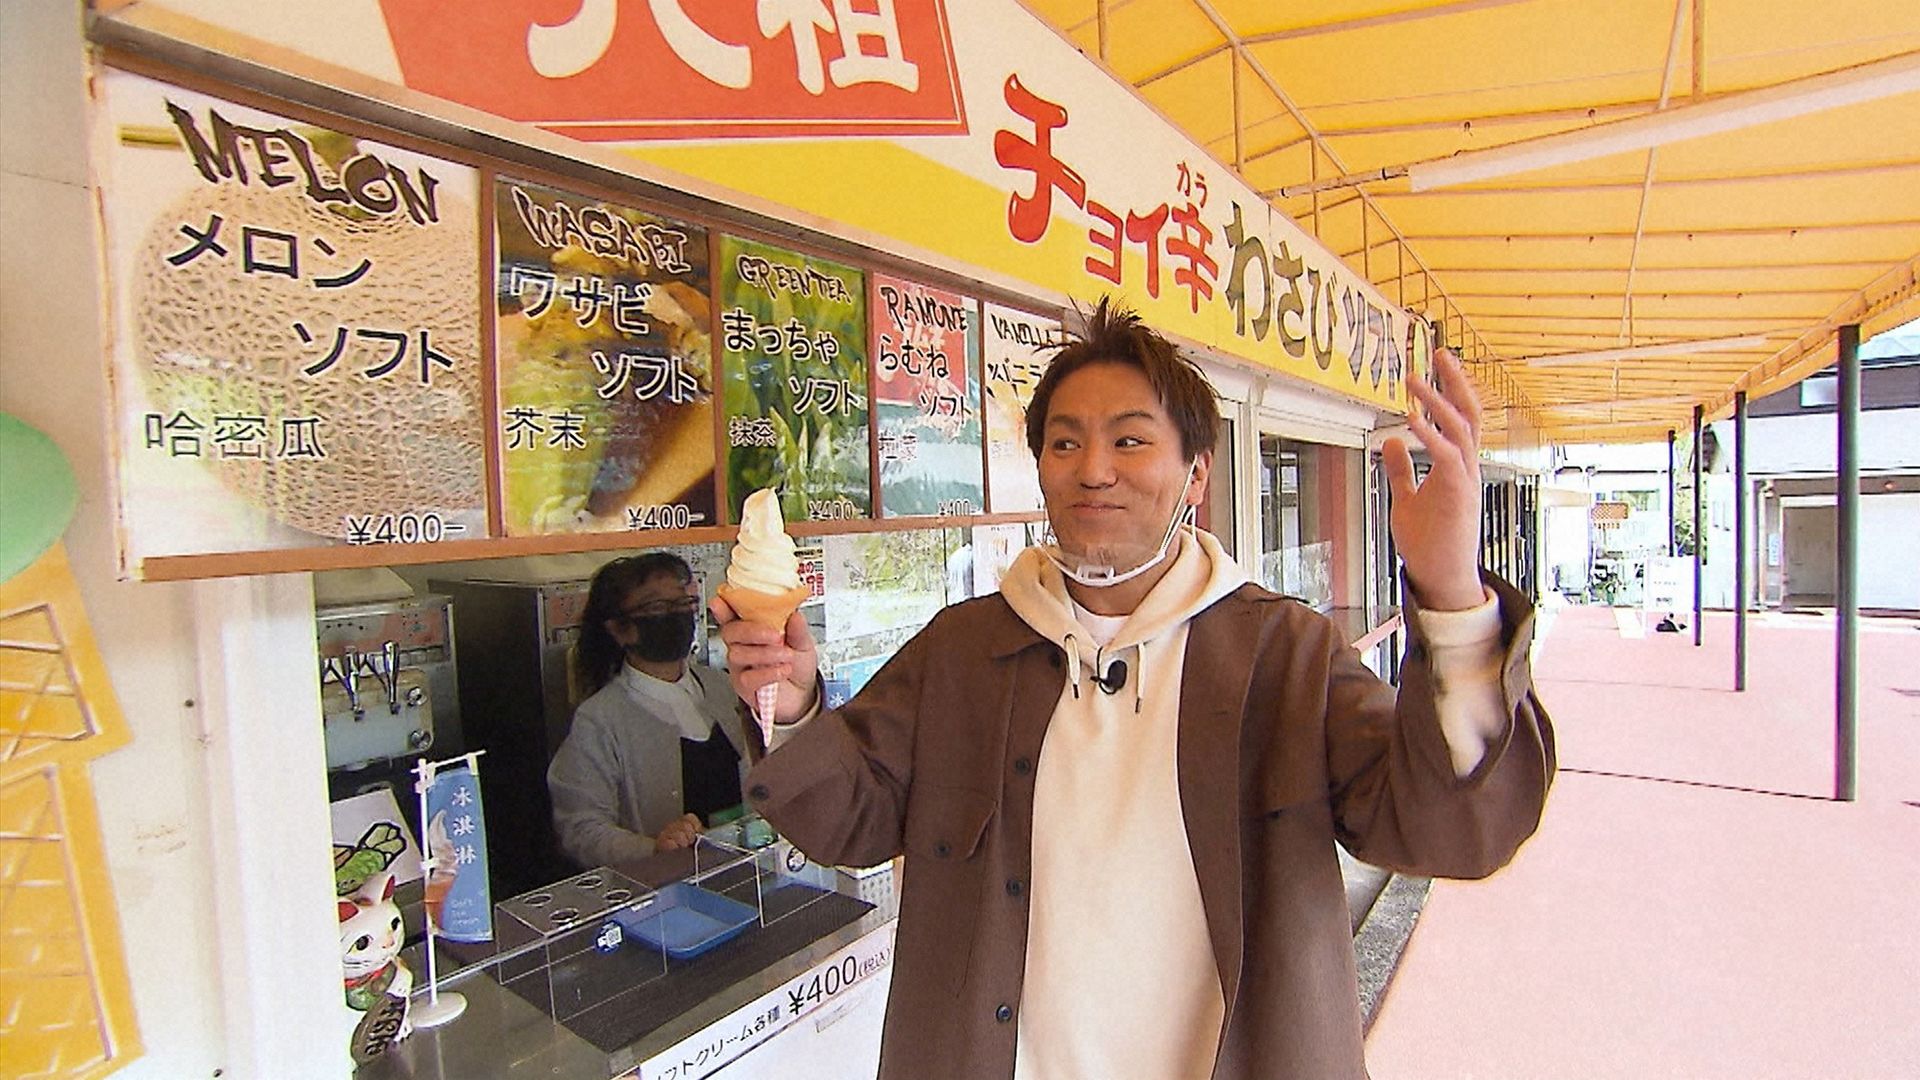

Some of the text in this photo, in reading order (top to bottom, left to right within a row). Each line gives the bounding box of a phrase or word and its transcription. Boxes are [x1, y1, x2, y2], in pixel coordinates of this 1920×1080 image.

[164, 96, 440, 226] MELON
[1176, 161, 1208, 208] カラ
[166, 213, 373, 288] メロン
[511, 184, 692, 275] WASABI
[509, 266, 653, 336] ワサビ
[879, 286, 969, 332] RAMUNE
[291, 321, 454, 384] ソフト
[721, 307, 840, 365] まっちゃ
[879, 335, 950, 379] らむね
[590, 350, 700, 405] ソフト
[788, 375, 866, 416] ソフト
[144, 410, 327, 460] 哈密瓜
[504, 408, 588, 451] 芥末
[728, 417, 778, 447] 抹茶
[920, 395, 973, 425] ソフト
